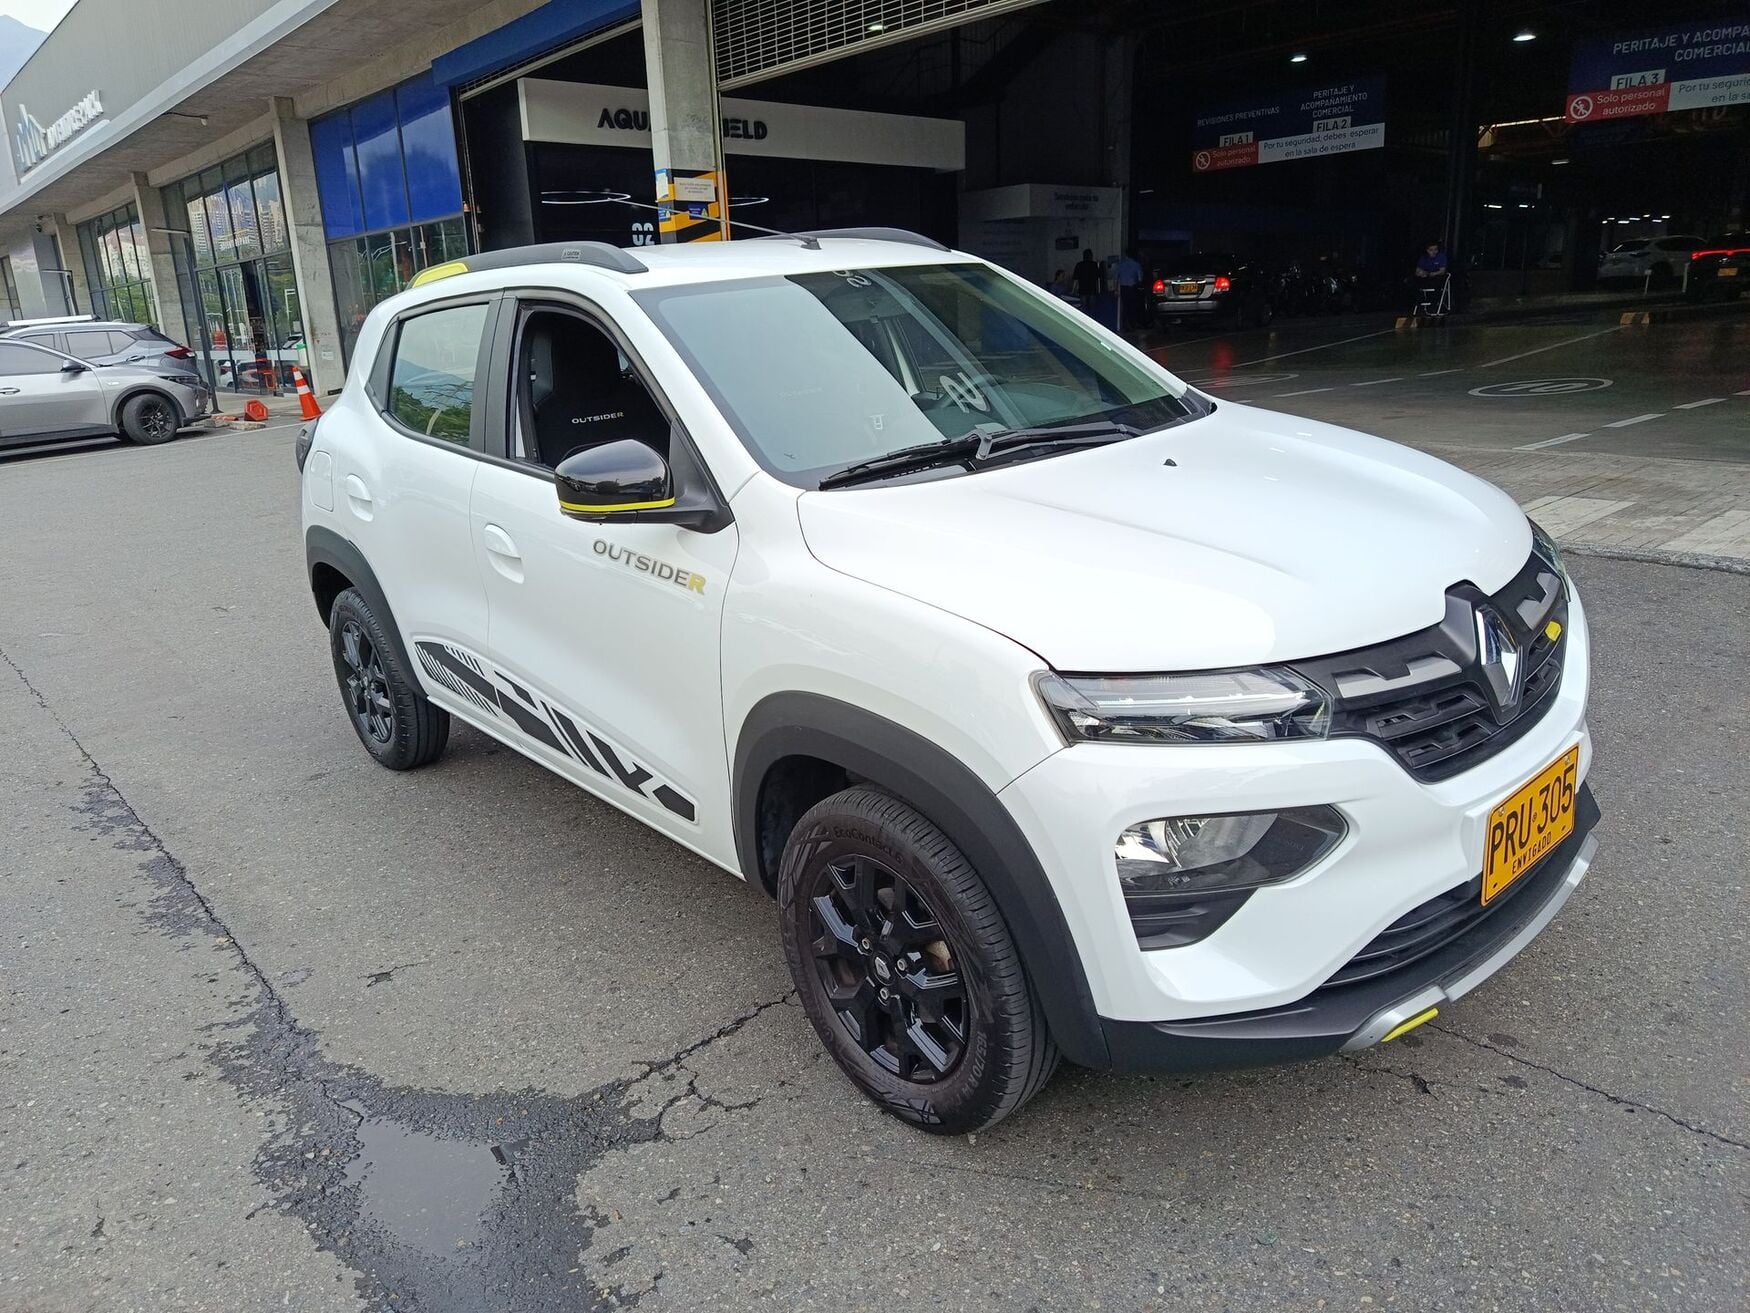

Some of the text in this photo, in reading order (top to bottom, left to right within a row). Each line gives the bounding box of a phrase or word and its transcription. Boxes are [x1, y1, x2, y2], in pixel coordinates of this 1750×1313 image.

[1613, 34, 1678, 54] PERITAJE
[1682, 33, 1691, 45] Y
[1616, 73, 1660, 89] FILA 3
[1679, 84, 1697, 93] Por
[1699, 83, 1710, 92] tu
[1313, 86, 1349, 99] PERITAJE
[1597, 88, 1665, 104] Solo personal
[1729, 92, 1738, 101] la
[1235, 105, 1280, 121] PREVENTIVAS
[1312, 104, 1354, 118] COMERCIAL
[1602, 101, 1656, 115] autorizado
[597, 108, 768, 140] AQU IELD
[1317, 119, 1348, 132] FILA 2
[1264, 142, 1275, 151] Por
[1323, 132, 1347, 141] debes
[1350, 128, 1379, 138] esperar
[1296, 148, 1303, 156] la
[1304, 146, 1318, 154] sala
[1320, 144, 1329, 152] de
[1331, 142, 1356, 151] espera
[571, 411, 625, 424] OUTSIDER
[593, 540, 707, 596] OUTSIDER
[1512, 831, 1552, 875] ENVIGADO
